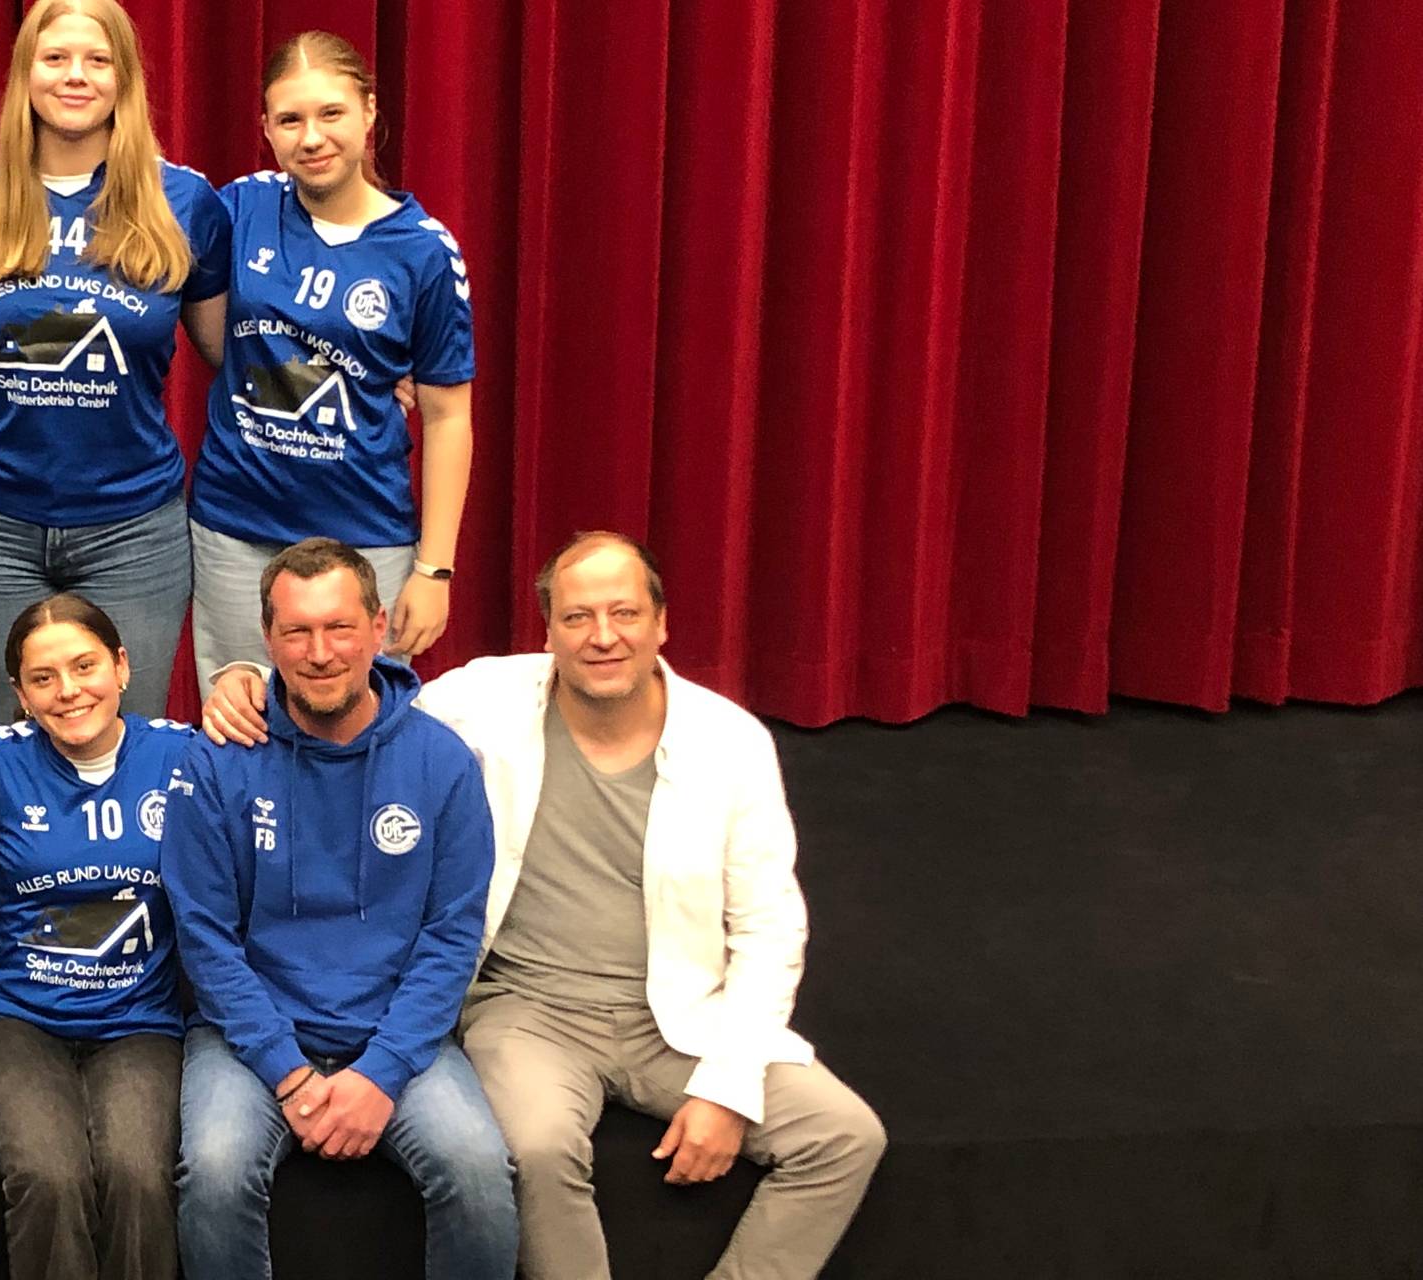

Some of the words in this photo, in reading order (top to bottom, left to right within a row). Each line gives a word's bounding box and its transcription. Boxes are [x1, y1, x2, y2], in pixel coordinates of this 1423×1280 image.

[47, 216, 88, 256] 44
[18, 274, 62, 290] RUND
[65, 276, 103, 295] UMS
[102, 283, 149, 317] DACH
[294, 266, 336, 310] 19
[258, 319, 299, 337] RUND
[300, 331, 332, 356] UMS
[330, 349, 368, 380] DACH
[30, 376, 118, 396] Dachtechnik
[77, 396, 110, 409] GmbH
[265, 422, 346, 450] Dachtechnik
[309, 447, 345, 461] GmbH
[81, 799, 124, 840] 10
[255, 827, 276, 851] FB
[16, 874, 55, 896] ALLES
[56, 865, 101, 884] RUND
[104, 864, 141, 882] UMS
[26, 953, 63, 972] Selva
[65, 959, 145, 977] Dachtechnik
[30, 970, 104, 990] Meisterbetrieb
